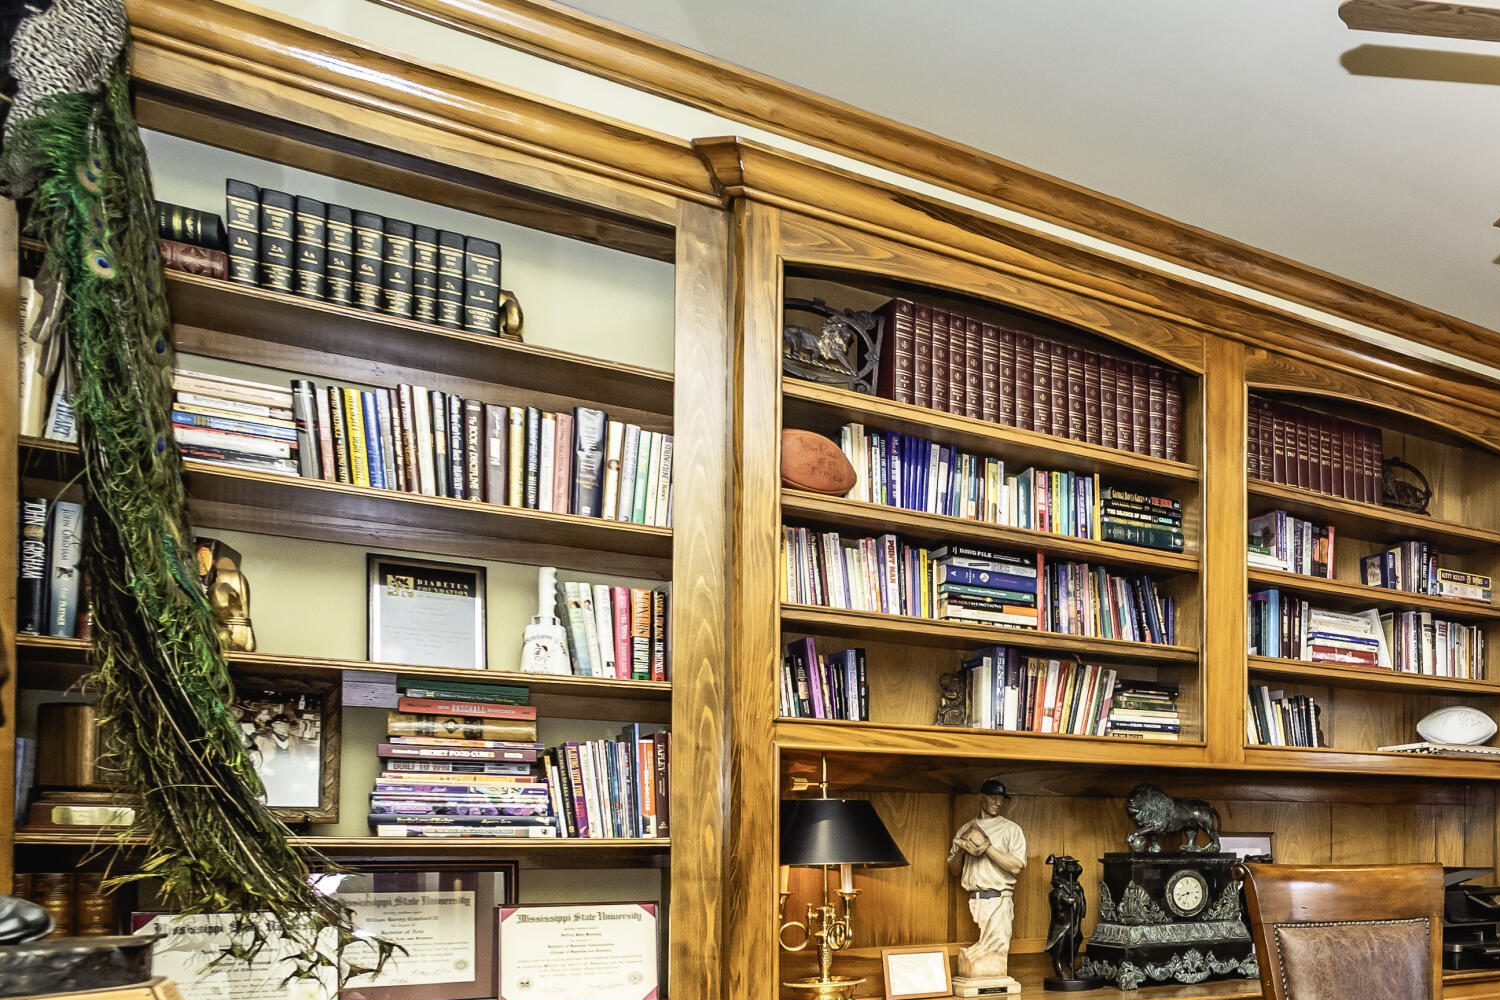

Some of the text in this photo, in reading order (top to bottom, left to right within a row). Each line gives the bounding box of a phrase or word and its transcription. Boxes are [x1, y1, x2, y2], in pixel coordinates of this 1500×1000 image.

[469, 452, 480, 490] DISCIPLINE
[60, 509, 74, 527] JOHN
[22, 500, 47, 580] JOHN GRISHAM
[60, 529, 74, 561] GRISHAM
[887, 540, 896, 565] POINT
[417, 579, 470, 589] DIABETES
[417, 585, 469, 597] FOUNDATION
[57, 600, 68, 626] PARTNER
[451, 704, 487, 714] BASEBALL
[657, 743, 666, 773] TAPLEY
[394, 896, 420, 906] State
[516, 911, 642, 924] Mississippi State University
